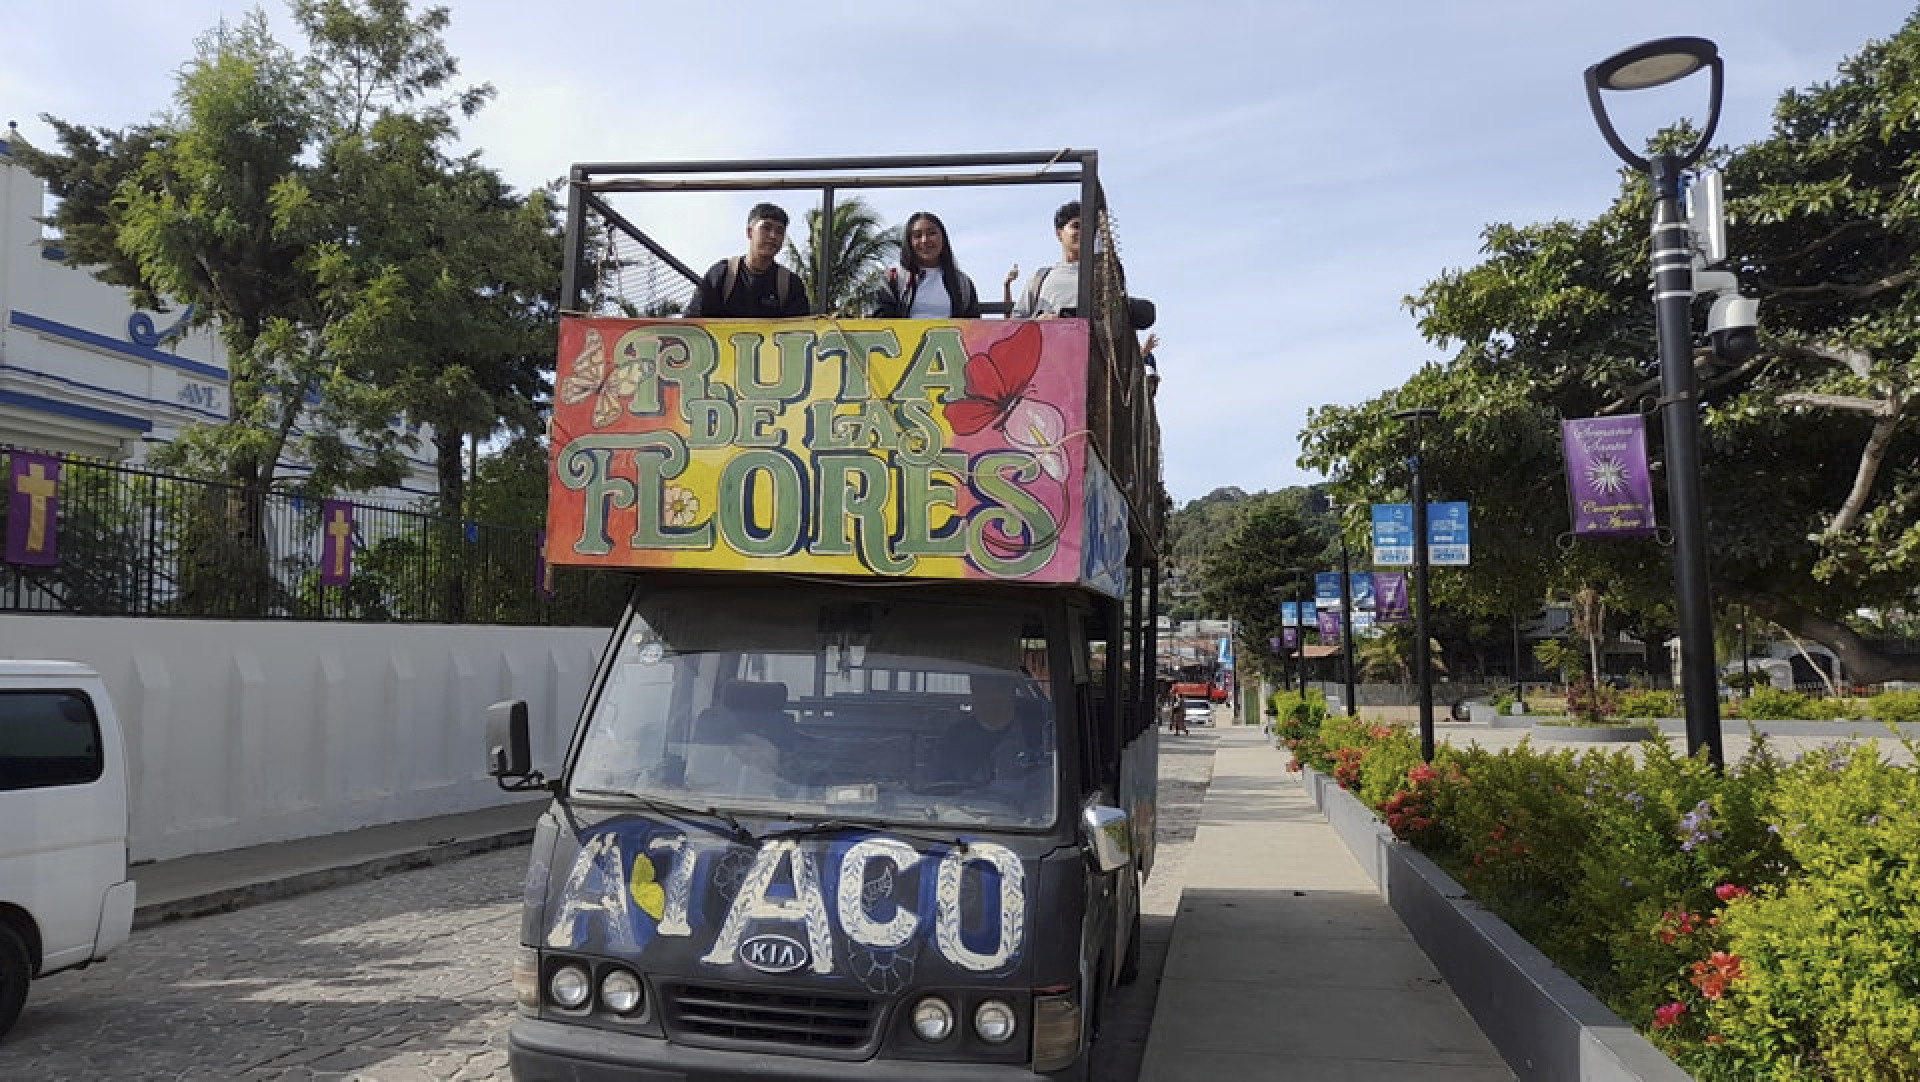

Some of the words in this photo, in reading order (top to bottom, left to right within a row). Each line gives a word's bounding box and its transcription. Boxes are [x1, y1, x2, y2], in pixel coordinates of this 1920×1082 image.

[615, 325, 968, 418] RUTA
[687, 399, 787, 448] DE
[812, 398, 943, 465] LAS
[558, 431, 1058, 578] FLORES
[547, 831, 1025, 973] ATACO
[751, 942, 795, 965] KIA
